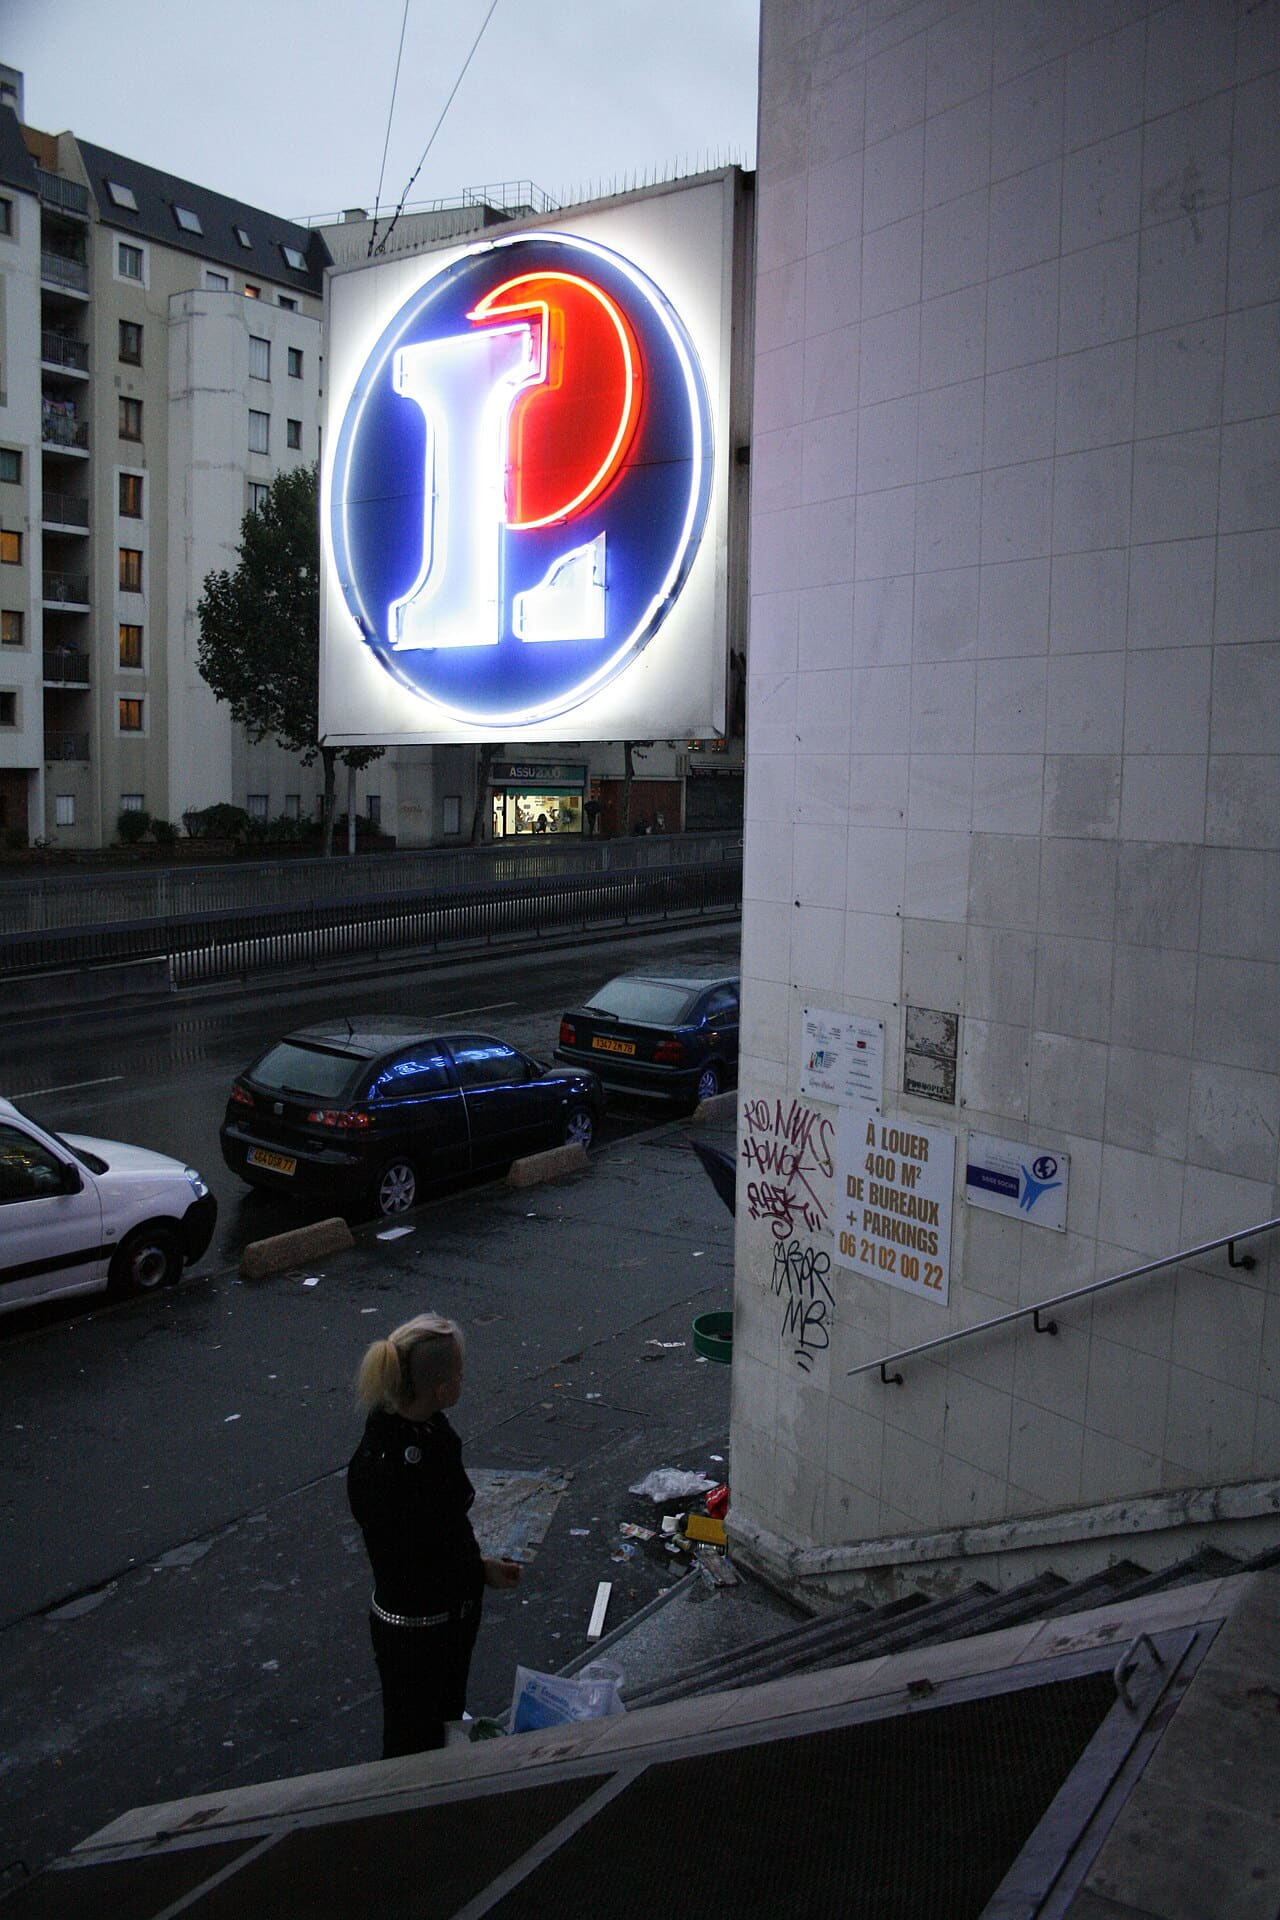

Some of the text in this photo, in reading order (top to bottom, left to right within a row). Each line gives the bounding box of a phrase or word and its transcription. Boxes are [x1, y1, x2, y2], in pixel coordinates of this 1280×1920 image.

[865, 1117, 929, 1162] À LOUER
[865, 1151, 896, 1182] 400
[846, 1174, 939, 1226] DE BUREAUX
[846, 1209, 938, 1256] + PARKINGS
[839, 1231, 943, 1292] 06 21 02 00 22
